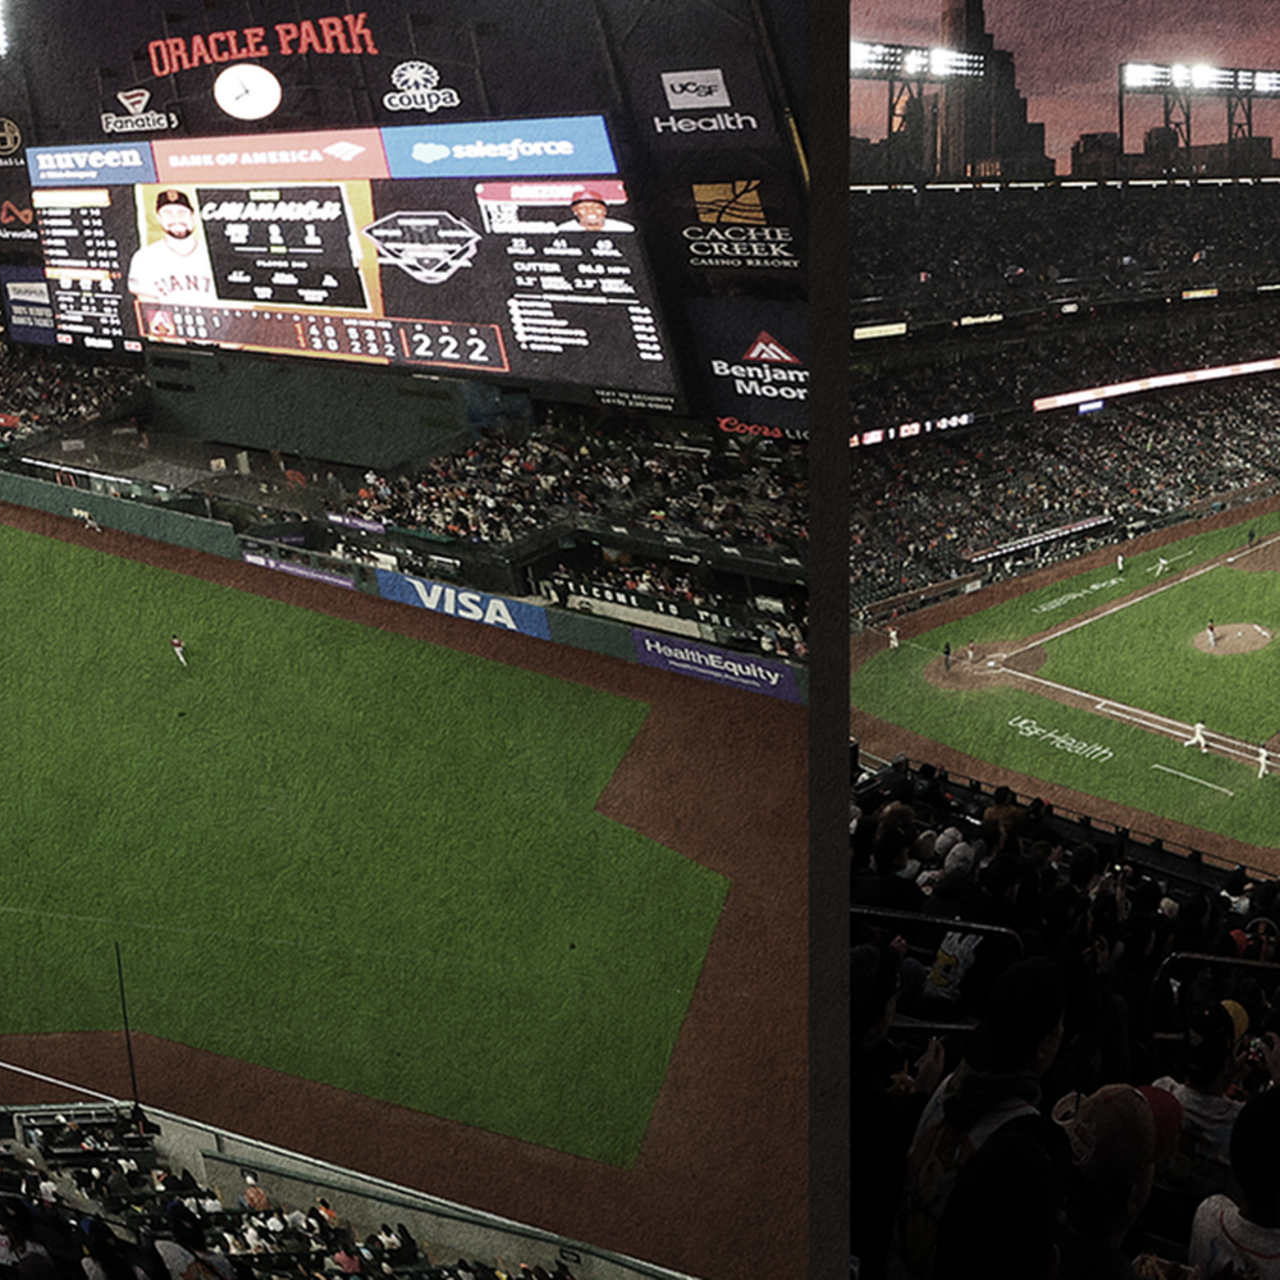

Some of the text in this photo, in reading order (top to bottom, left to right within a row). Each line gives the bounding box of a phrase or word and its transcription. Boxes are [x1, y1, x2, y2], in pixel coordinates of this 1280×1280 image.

[147, 12, 380, 78] ORACLE PARK
[385, 88, 460, 114] coupa
[670, 81, 720, 99] UCSF
[654, 112, 758, 134] Health
[36, 148, 143, 170] nuveen
[169, 149, 323, 168] BANK OF AMERICA
[452, 138, 574, 161] salesforce
[682, 226, 793, 242] CACHE
[689, 241, 794, 257] CREEK
[689, 257, 800, 269] CASINO RESORT
[412, 333, 489, 362] 2 2 2
[735, 379, 809, 401] Moor
[716, 416, 783, 439] Coors
[404, 577, 518, 631] VISA
[644, 638, 782, 686] HealthEquity
[1039, 728, 1114, 764] Health
